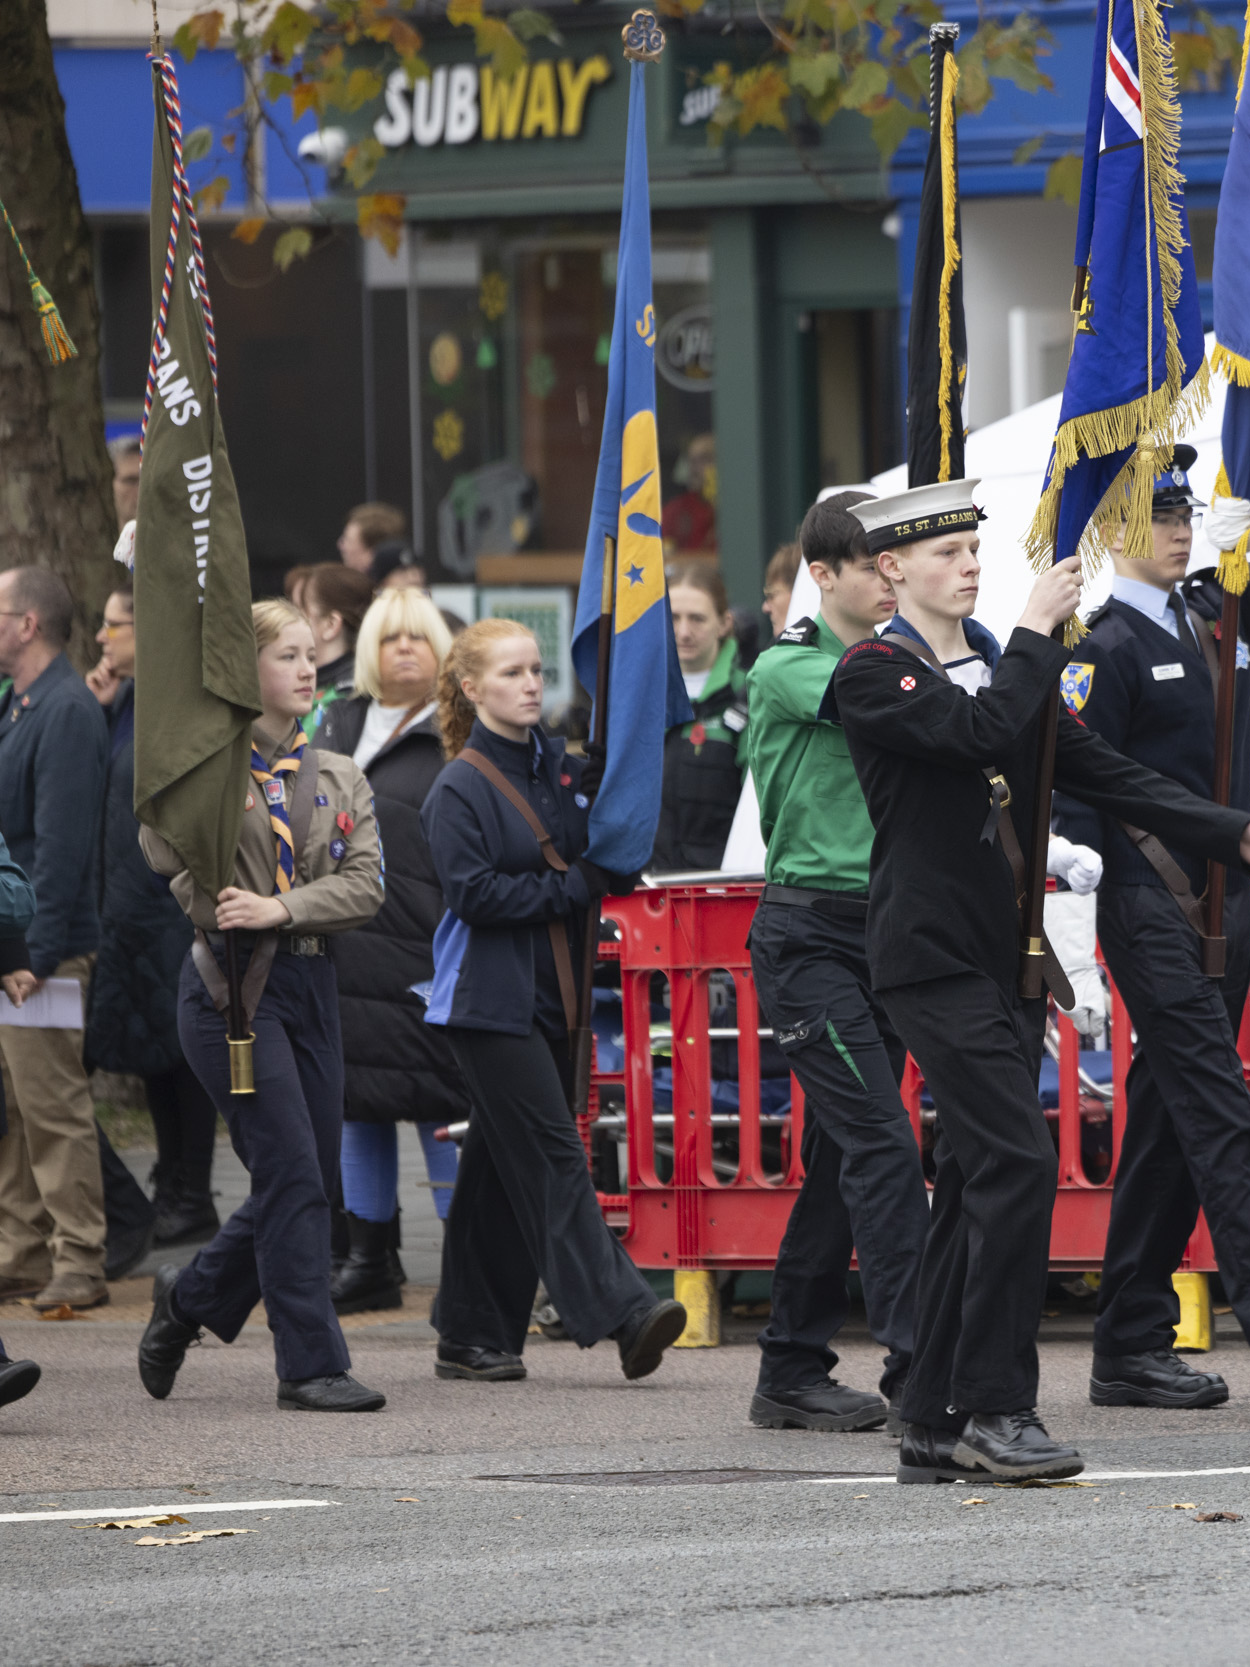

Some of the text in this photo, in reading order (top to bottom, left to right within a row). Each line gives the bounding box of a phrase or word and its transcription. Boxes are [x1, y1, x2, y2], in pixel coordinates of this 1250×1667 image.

[373, 56, 610, 147] SUBWAY
[915, 519, 933, 531] ST.
[938, 512, 973, 526] ALBANS
[850, 643, 873, 655] CADET
[872, 643, 894, 656] CORPS
